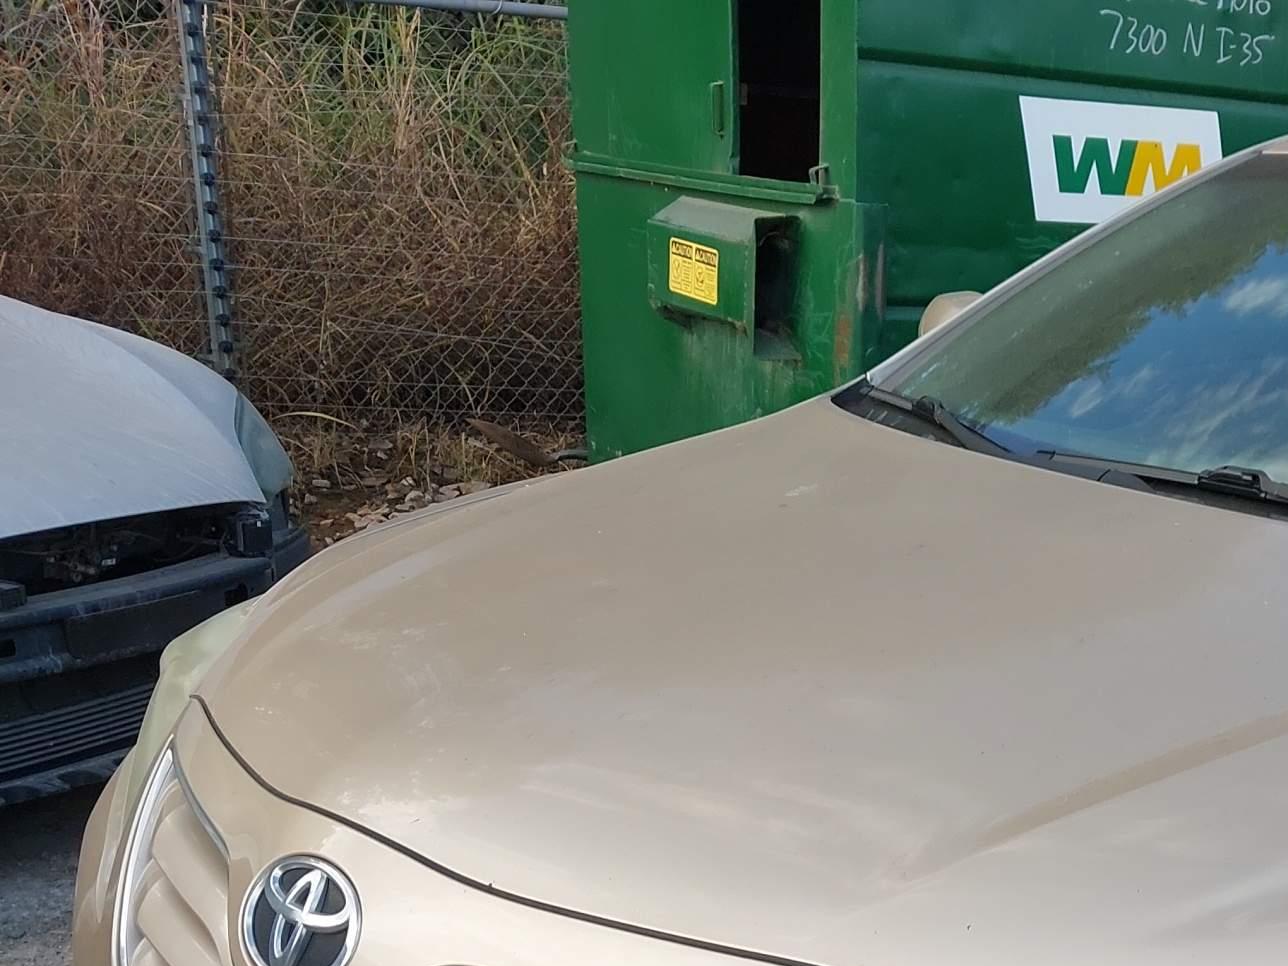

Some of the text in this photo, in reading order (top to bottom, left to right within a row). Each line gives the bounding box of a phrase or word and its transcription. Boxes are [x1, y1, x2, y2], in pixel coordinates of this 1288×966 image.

[1100, 9, 1276, 66] 7300 N I-35
[1052, 135, 1202, 196] WM
